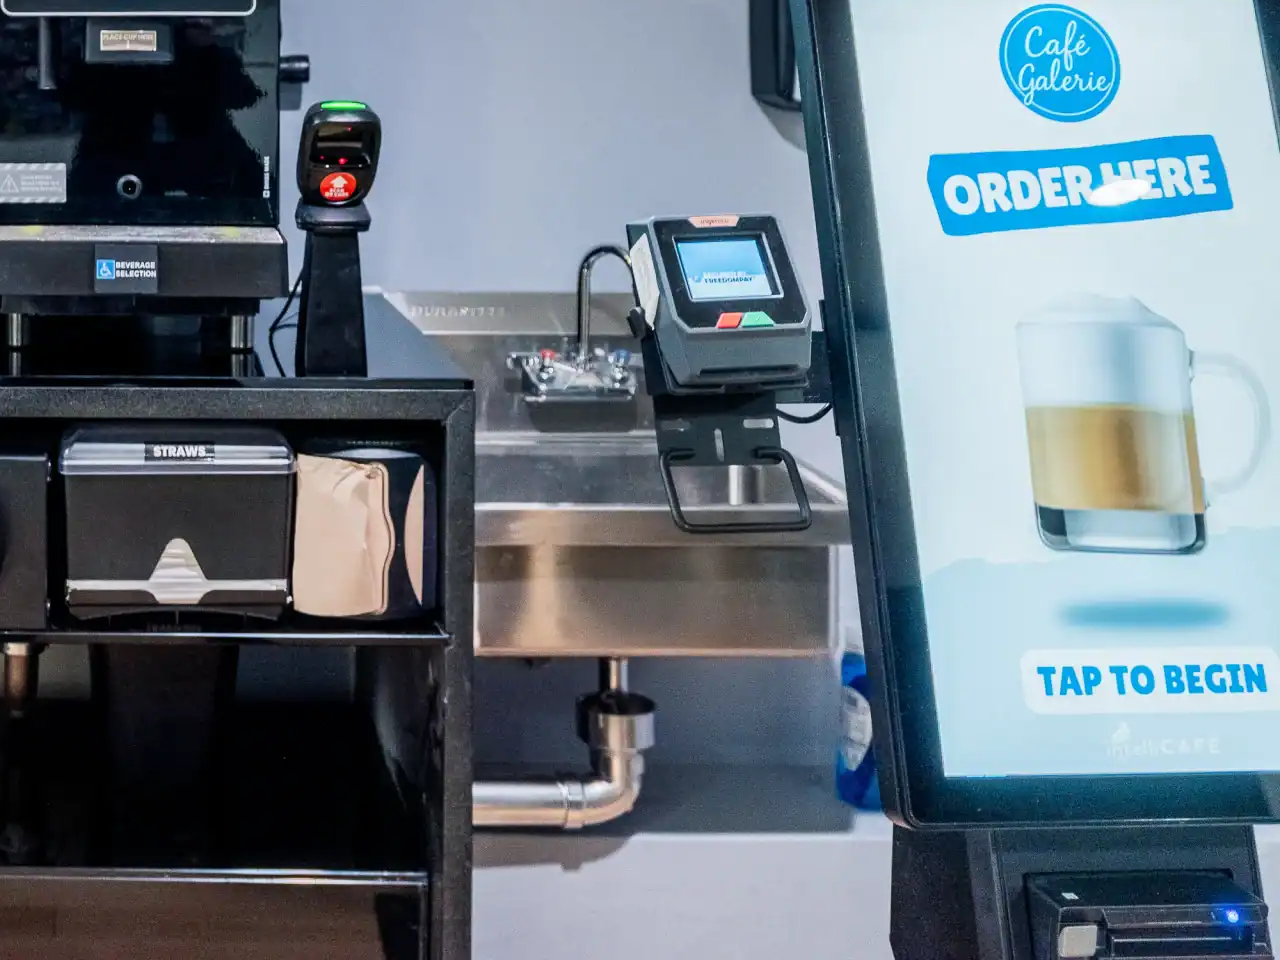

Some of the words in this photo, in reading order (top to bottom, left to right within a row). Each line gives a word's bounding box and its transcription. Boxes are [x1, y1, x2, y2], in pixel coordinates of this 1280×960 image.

[1024, 19, 1091, 71] Café
[1018, 58, 1113, 106] Galerie
[943, 164, 1095, 216] ORDER
[1099, 154, 1217, 205] HERE
[115, 261, 156, 269] BEVERAGE
[115, 270, 157, 278] SELECTION
[153, 445, 206, 458] STRAWS
[1036, 666, 1102, 696] TAP
[1109, 665, 1156, 695] TO
[1163, 664, 1268, 694] BEGIN
